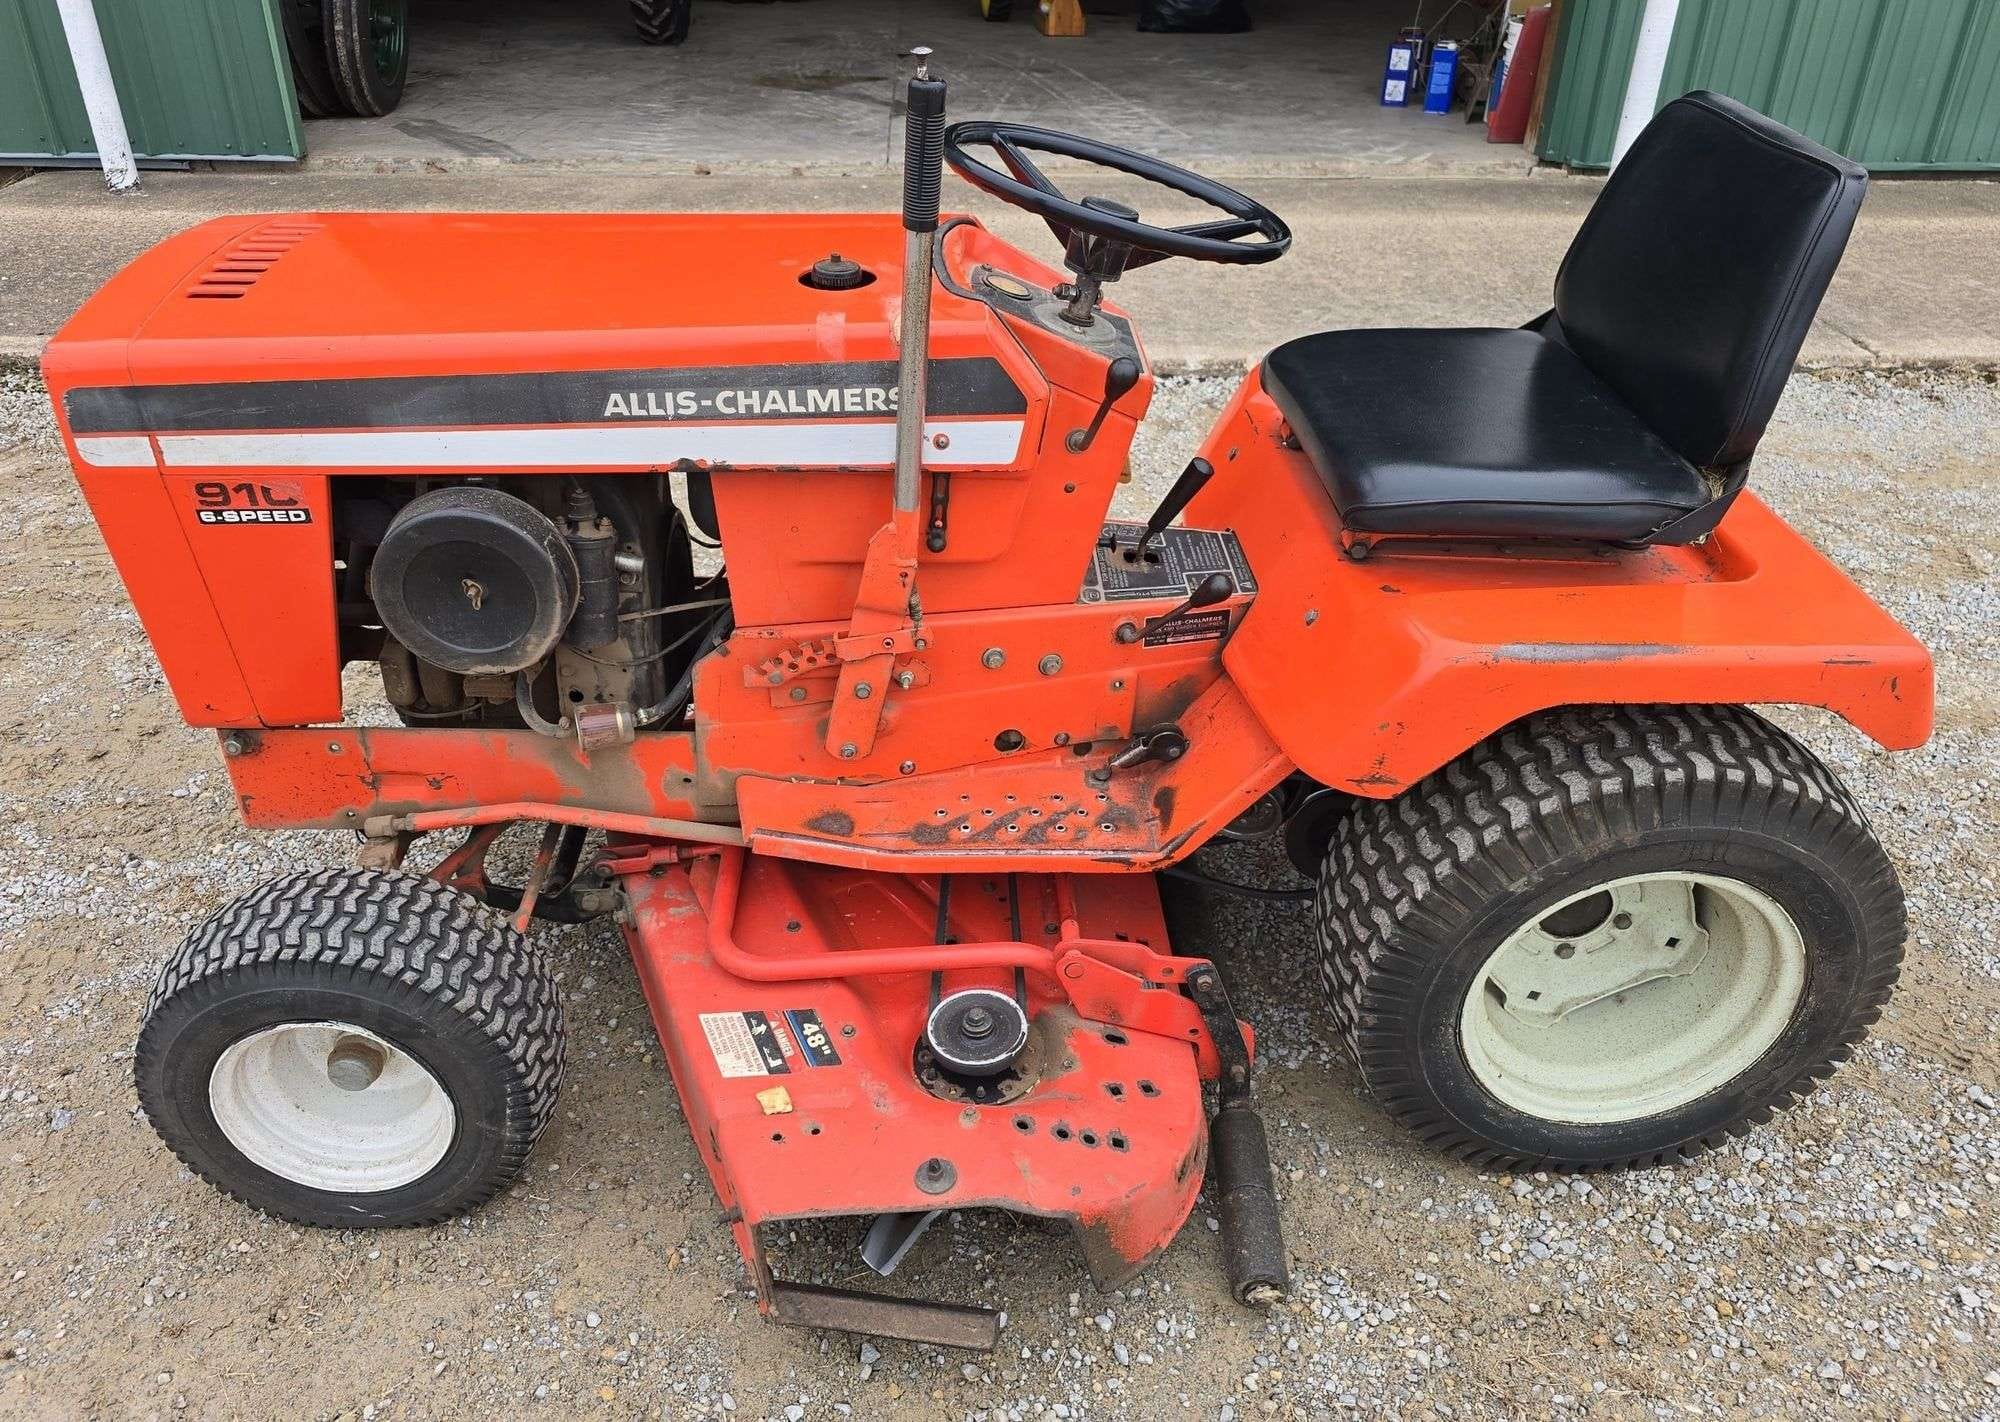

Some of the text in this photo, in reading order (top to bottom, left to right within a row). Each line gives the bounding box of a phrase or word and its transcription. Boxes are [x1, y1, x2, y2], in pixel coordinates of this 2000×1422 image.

[603, 387, 899, 416] ALLIS-CHALMERS
[199, 510, 307, 522] 6-SPEED
[802, 1023, 832, 1055] 48"
